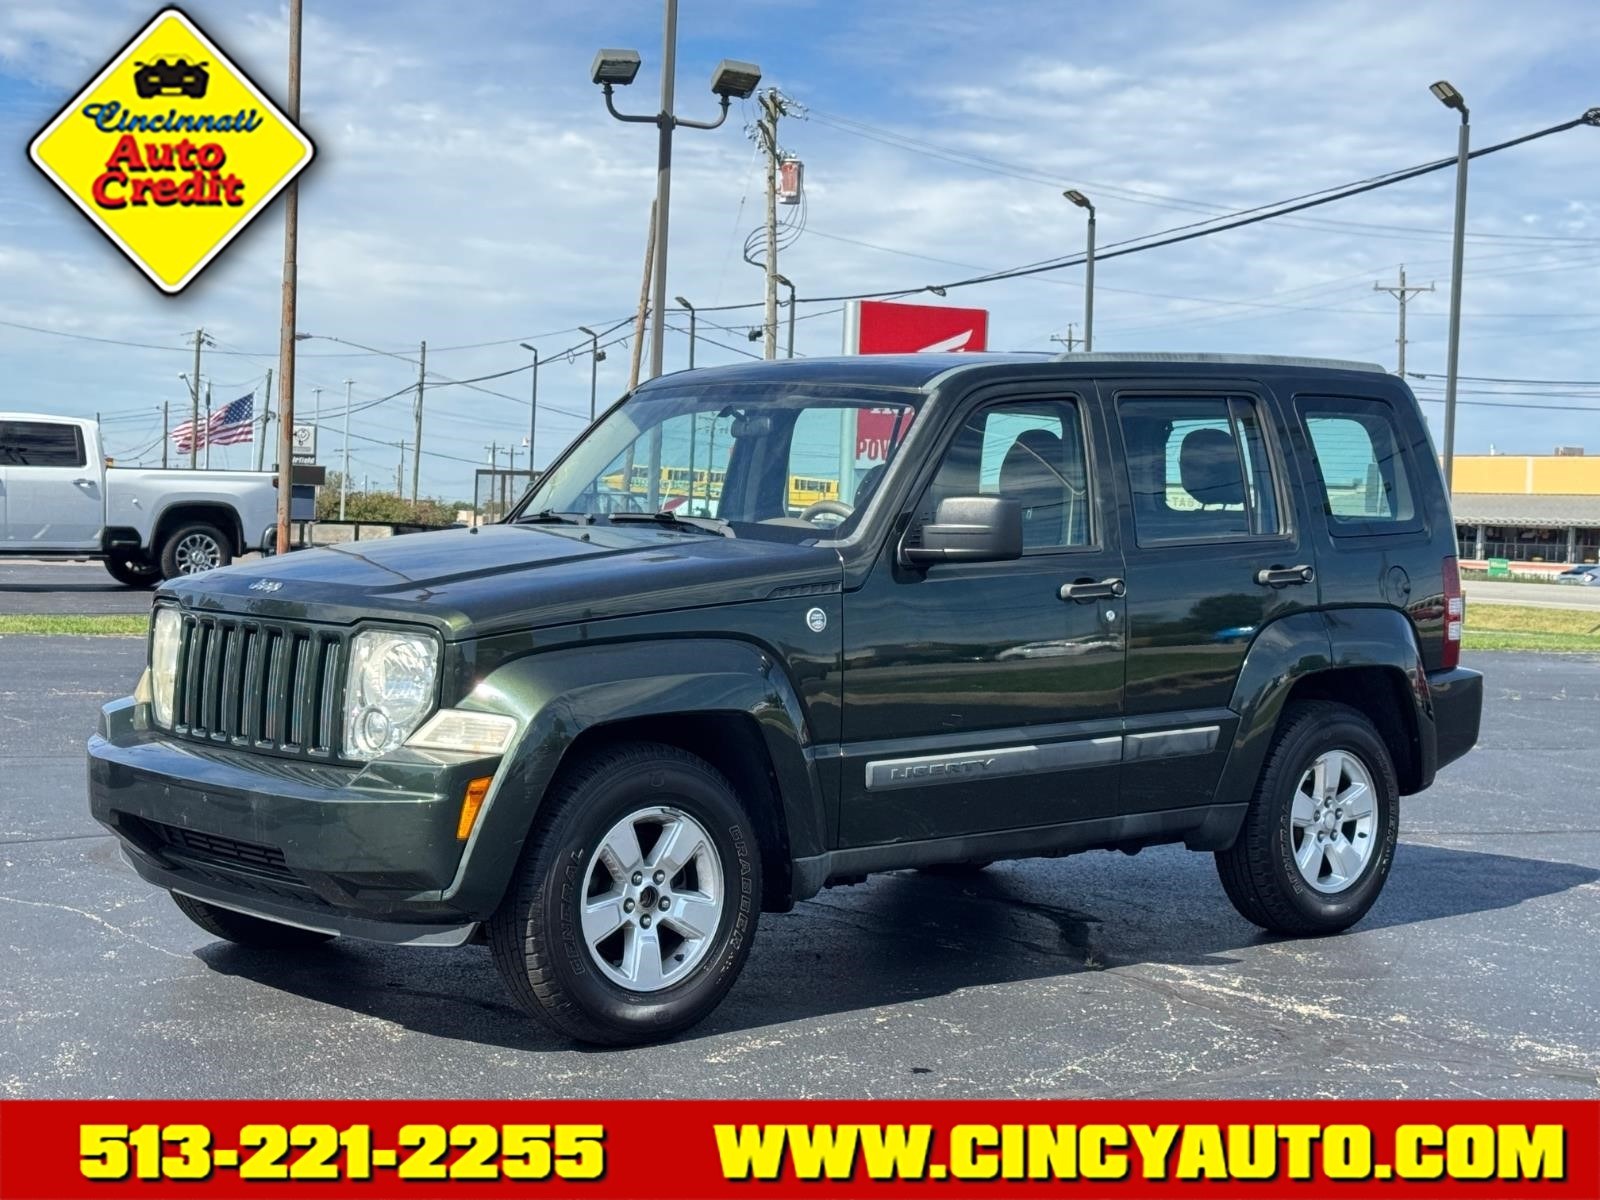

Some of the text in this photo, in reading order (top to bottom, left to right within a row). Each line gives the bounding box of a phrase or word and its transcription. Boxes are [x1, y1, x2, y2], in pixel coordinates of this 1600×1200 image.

[890, 758, 996, 781] LIBERTY
[561, 848, 586, 975] GENERAL
[728, 823, 752, 950] GRABBER
